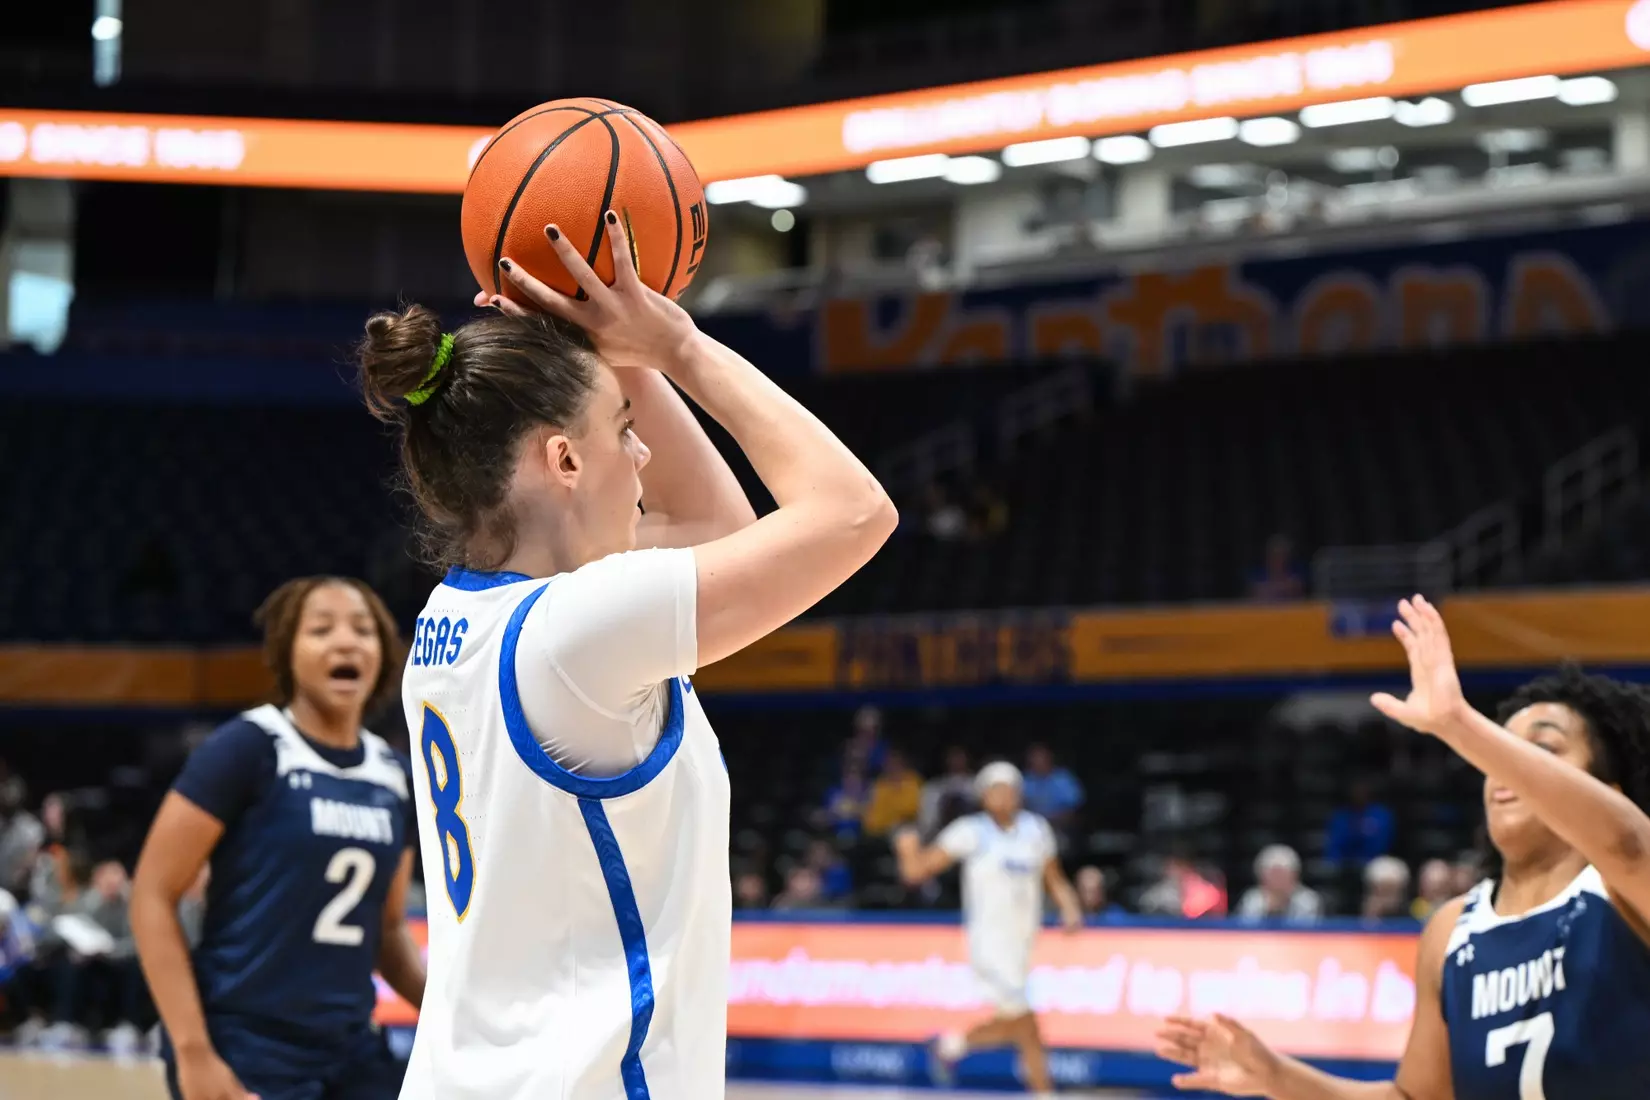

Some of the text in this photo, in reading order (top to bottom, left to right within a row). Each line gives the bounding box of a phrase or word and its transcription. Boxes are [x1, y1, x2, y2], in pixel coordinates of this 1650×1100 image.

[411, 616, 469, 667] EGAS
[310, 797, 393, 845] MOUNT
[420, 700, 476, 924] 8
[312, 847, 376, 946] 2
[1471, 946, 1566, 1019] MOUNT
[1485, 1011, 1554, 1100] 7
